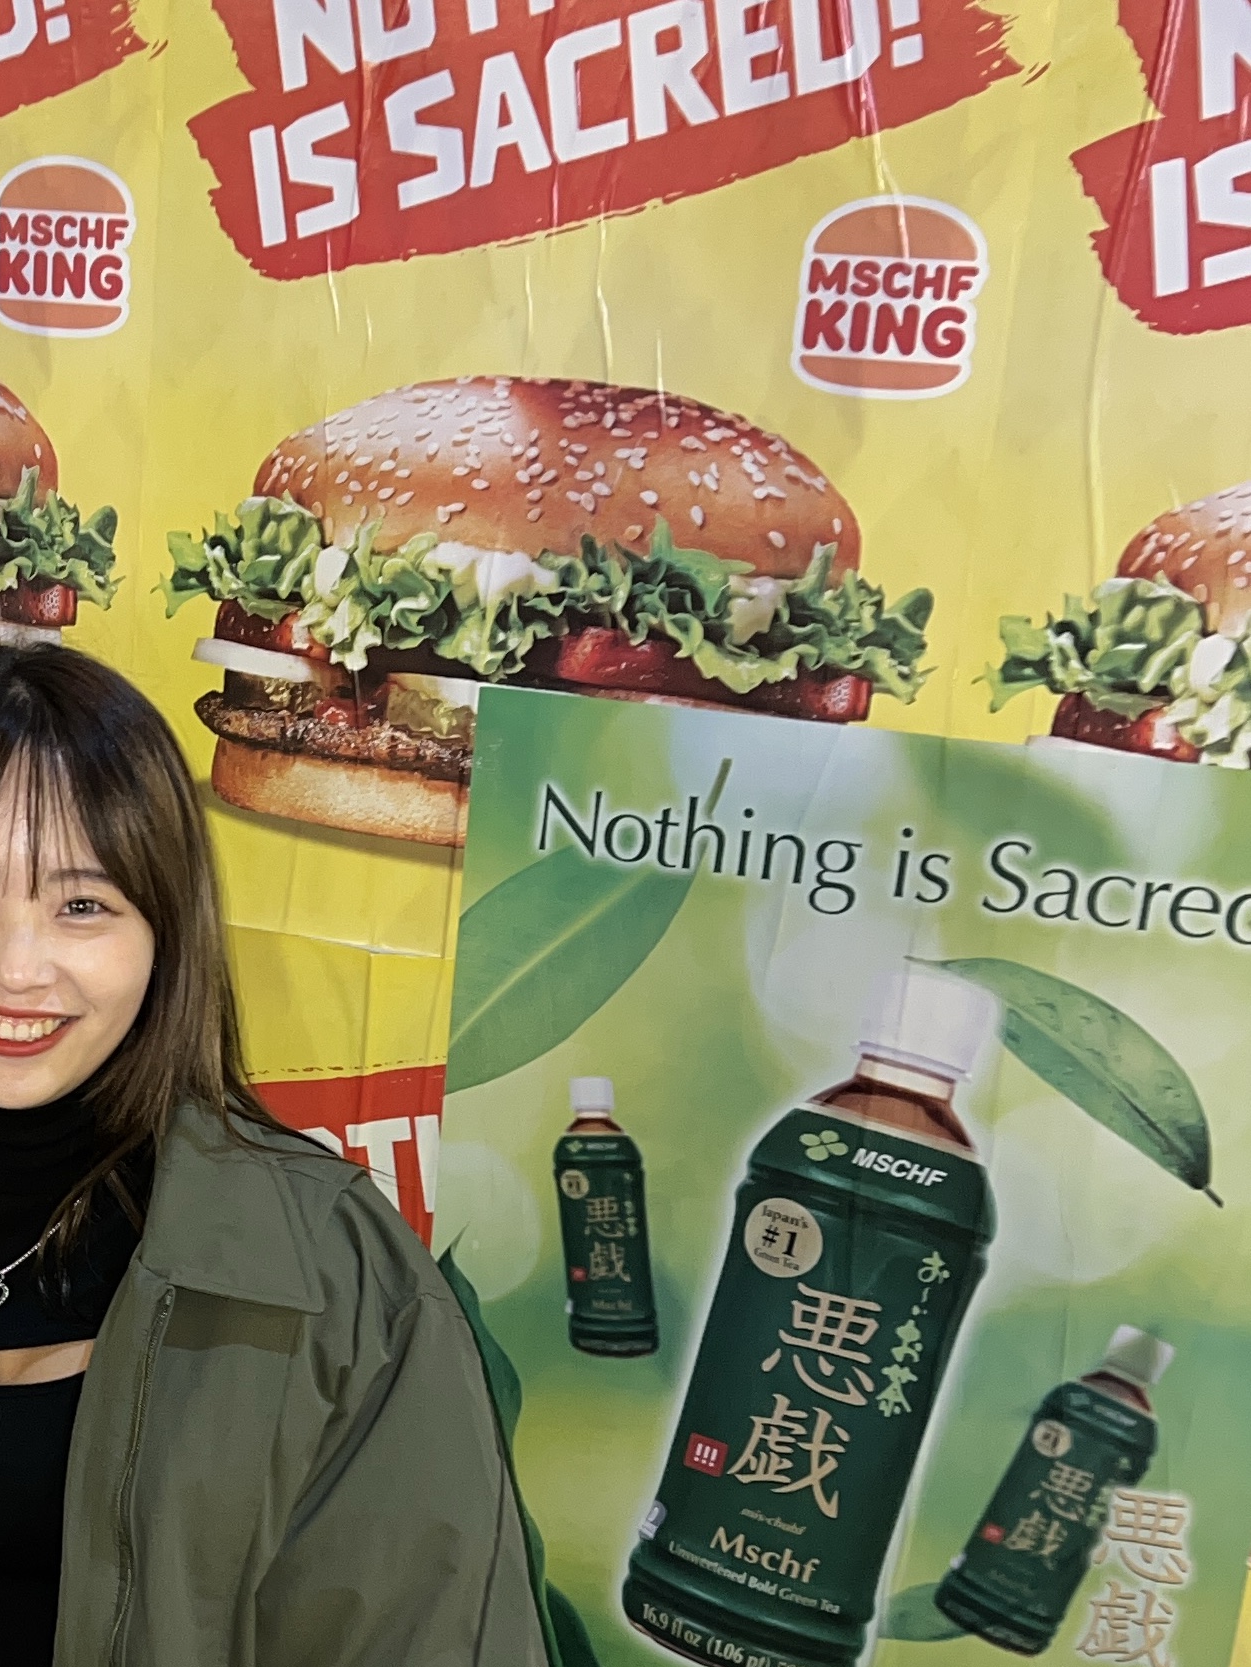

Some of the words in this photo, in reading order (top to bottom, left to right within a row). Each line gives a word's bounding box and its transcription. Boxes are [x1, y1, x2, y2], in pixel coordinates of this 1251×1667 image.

[249, 102, 360, 247] IS
[384, 0, 924, 210] SACRED!
[808, 258, 980, 301] MSCHF
[803, 298, 968, 359] KING
[539, 784, 862, 915] Nothing
[893, 828, 950, 903] is
[851, 1147, 948, 1187] MSCHF
[762, 1224, 799, 1258] #1
[727, 1281, 883, 1520] 悪戯
[710, 1526, 821, 1584] Mschf
[747, 1574, 778, 1596] Bold
[642, 1603, 669, 1629] 16.9
[683, 1629, 703, 1648] oz
